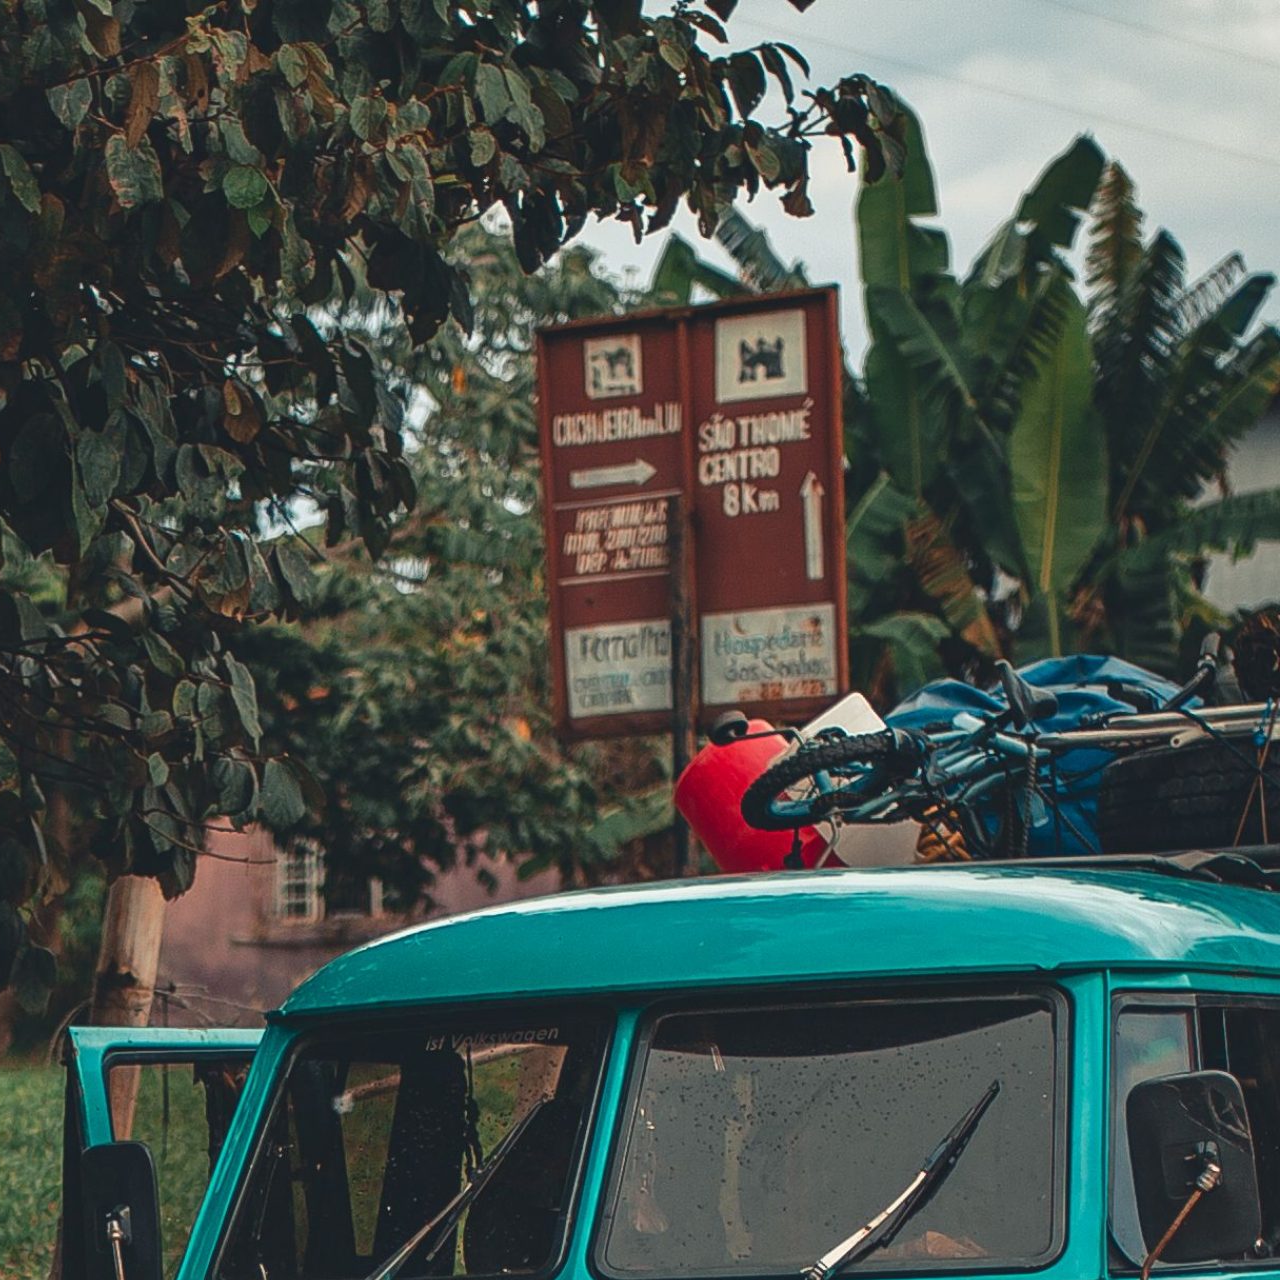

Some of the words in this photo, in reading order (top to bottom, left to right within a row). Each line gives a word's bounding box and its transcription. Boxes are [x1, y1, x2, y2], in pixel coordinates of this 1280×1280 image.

[699, 413, 736, 452] SÃO
[699, 446, 780, 486] CENTRO
[450, 1027, 560, 1049] Volkswagen
